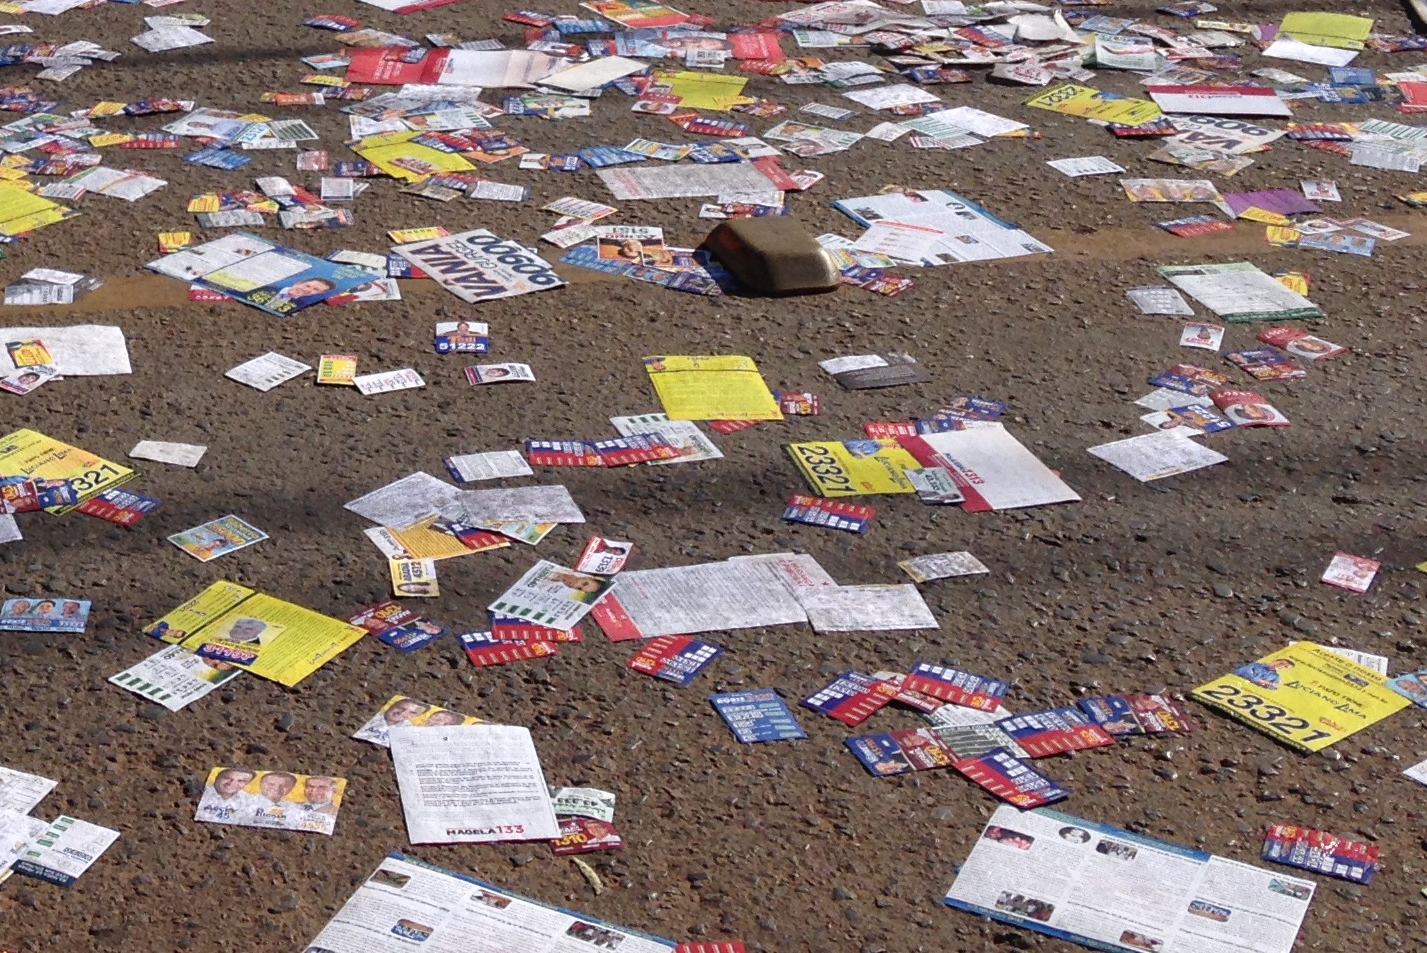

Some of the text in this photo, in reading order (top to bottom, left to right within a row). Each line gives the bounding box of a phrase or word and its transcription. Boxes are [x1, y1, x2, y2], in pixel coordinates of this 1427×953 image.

[466, 235, 563, 286] 90900
[439, 342, 485, 351] 51222
[798, 445, 857, 491] 23321
[1202, 684, 1332, 742] 23321
[1284, 680, 1340, 706] LUCIANO
